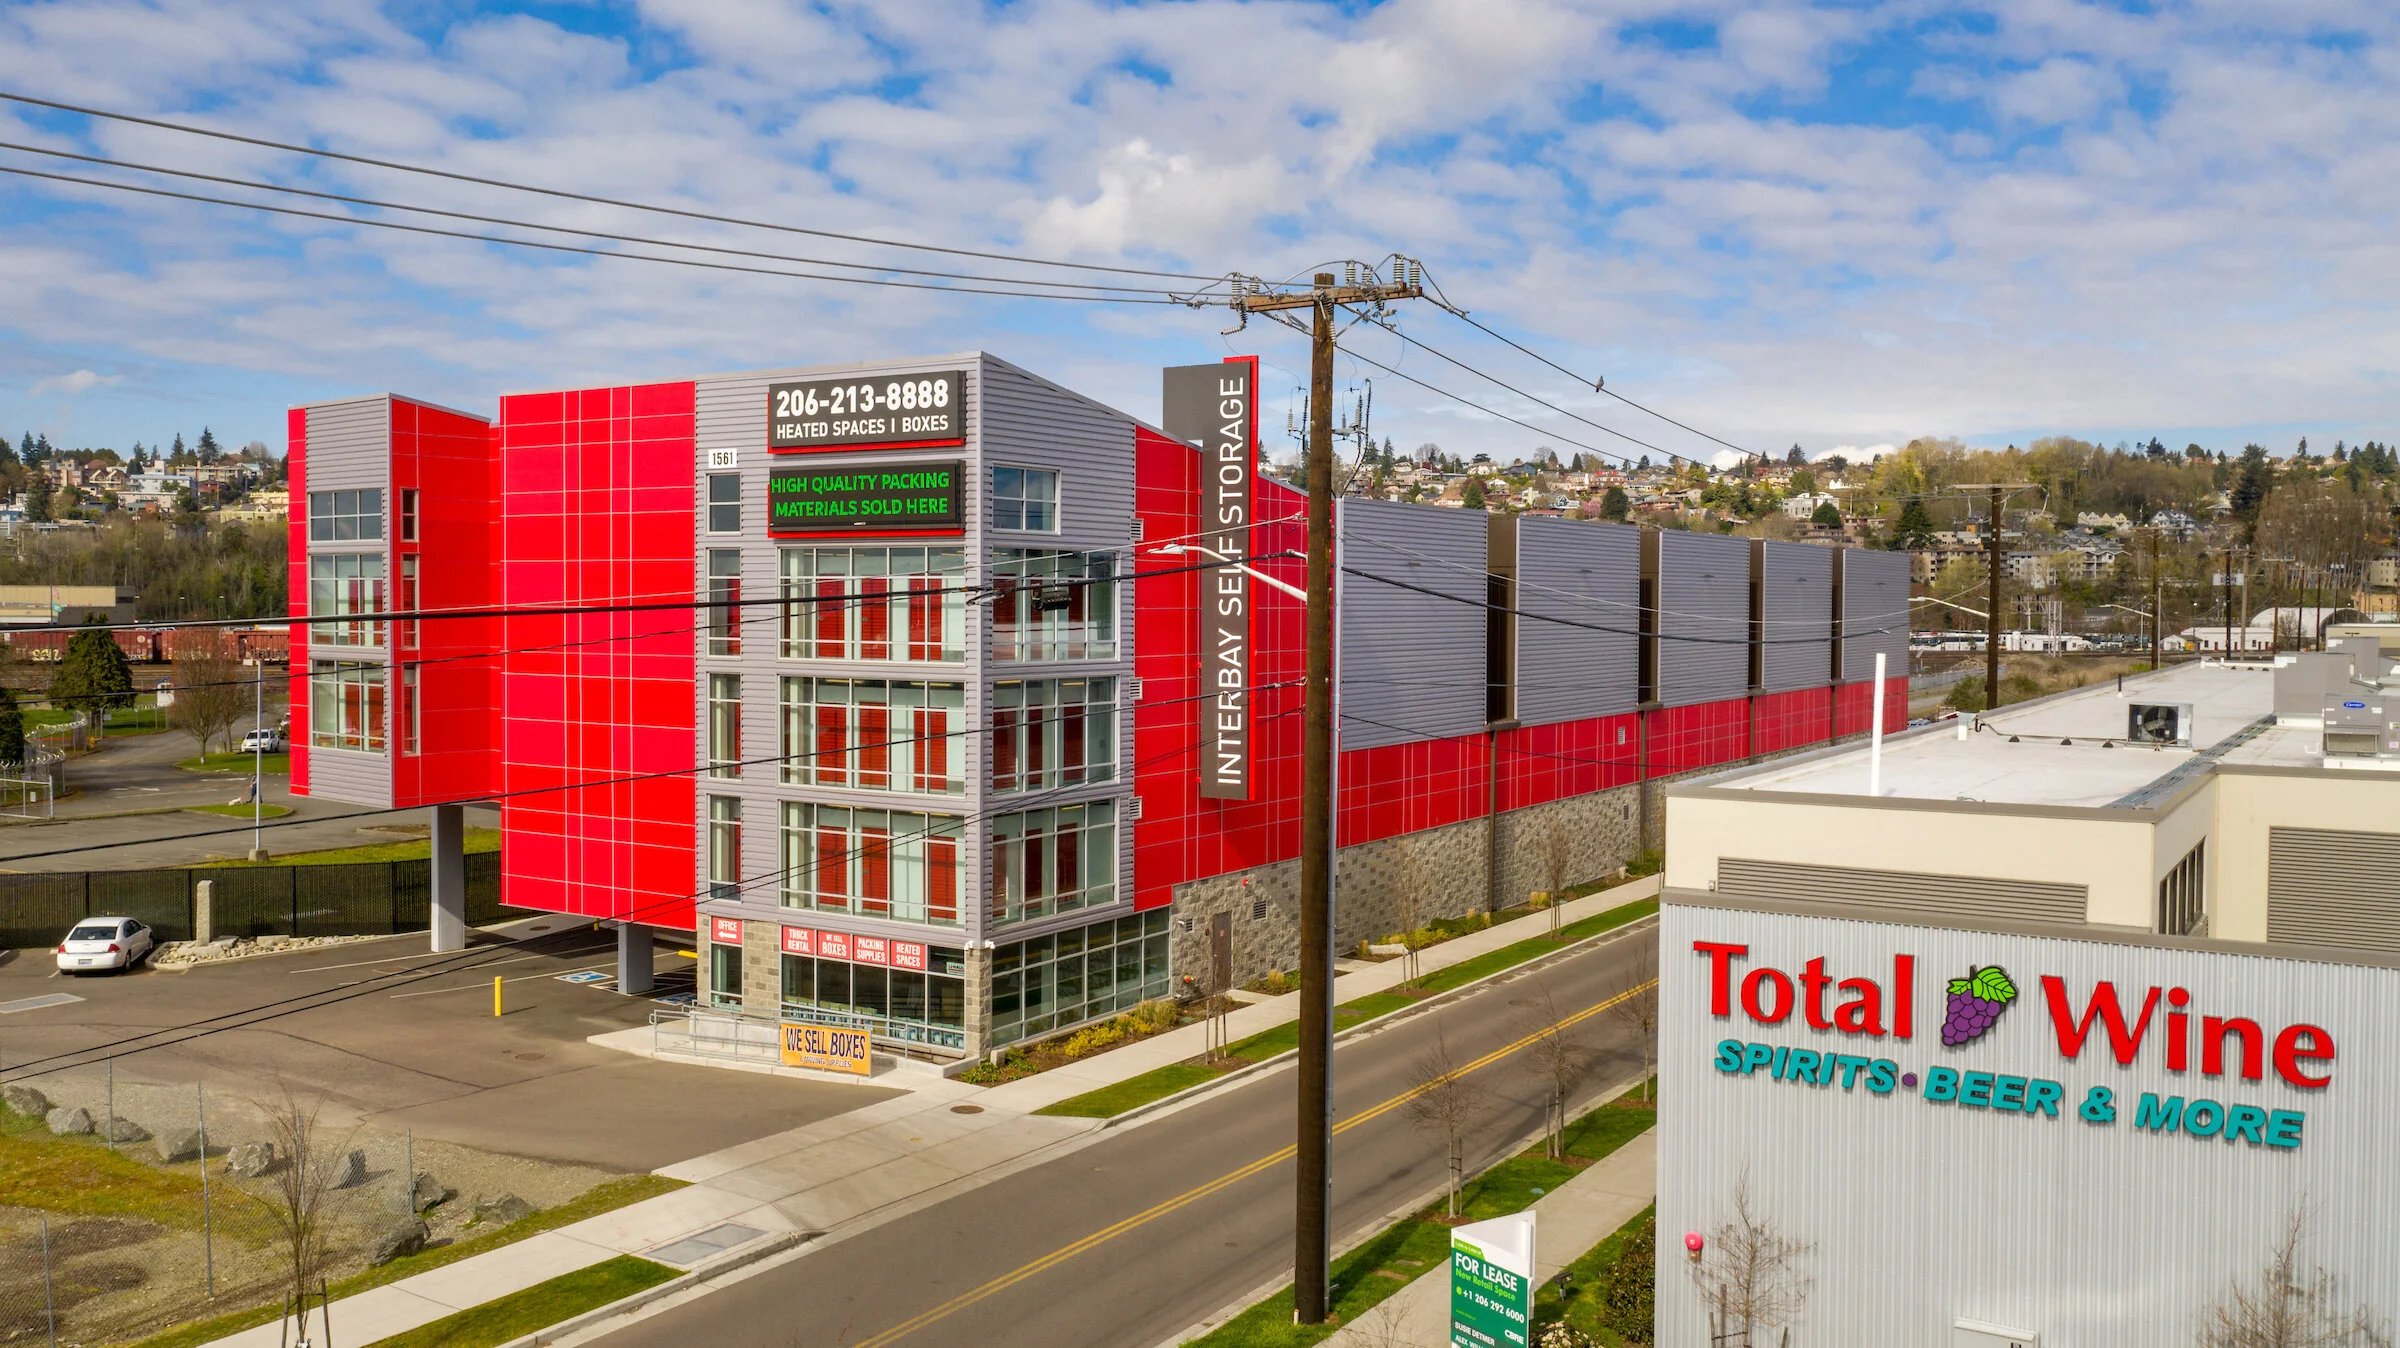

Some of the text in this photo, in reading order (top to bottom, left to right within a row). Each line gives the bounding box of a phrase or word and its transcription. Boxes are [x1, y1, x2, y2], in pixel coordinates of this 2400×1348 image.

[776, 379, 949, 418] 206-213-8888
[776, 422, 829, 440] HEATED
[832, 418, 885, 436] SPACES
[902, 415, 949, 433] BOXES
[712, 452, 734, 466] 1561
[771, 472, 950, 495] HIGH QUALITY PACKING
[775, 497, 949, 518] MATERIALS SOLD HERE
[1217, 377, 1244, 784] INTERBAY SELF STORAGE
[717, 919, 738, 932] OFFICE
[788, 928, 809, 940] TRUCK
[825, 934, 844, 943] WE SELL
[787, 939, 811, 952] RENTAL
[822, 941, 847, 957] BOXES
[858, 937, 885, 951] PACKING
[896, 942, 921, 956] HEATED
[856, 949, 886, 963] SUPPLIES
[896, 953, 921, 968] SPACES
[1693, 940, 2335, 1088] Total Wine
[786, 1027, 866, 1060] WE SELL BOXES
[826, 1058, 852, 1068] SUPPLIES
[1714, 1039, 2305, 1148] SPIRITS BEER & MORE
[1455, 1252, 1518, 1292] FOR LEASE
[1455, 1268, 1516, 1302] New Retail Space
[1463, 1290, 1473, 1300] +1
[1474, 1293, 1489, 1307] 206
[1490, 1300, 1504, 1315] 292
[1505, 1307, 1525, 1324] 6000
[1454, 1335, 1469, 1346] ALEX
[1504, 1329, 1525, 1345] CBRE
